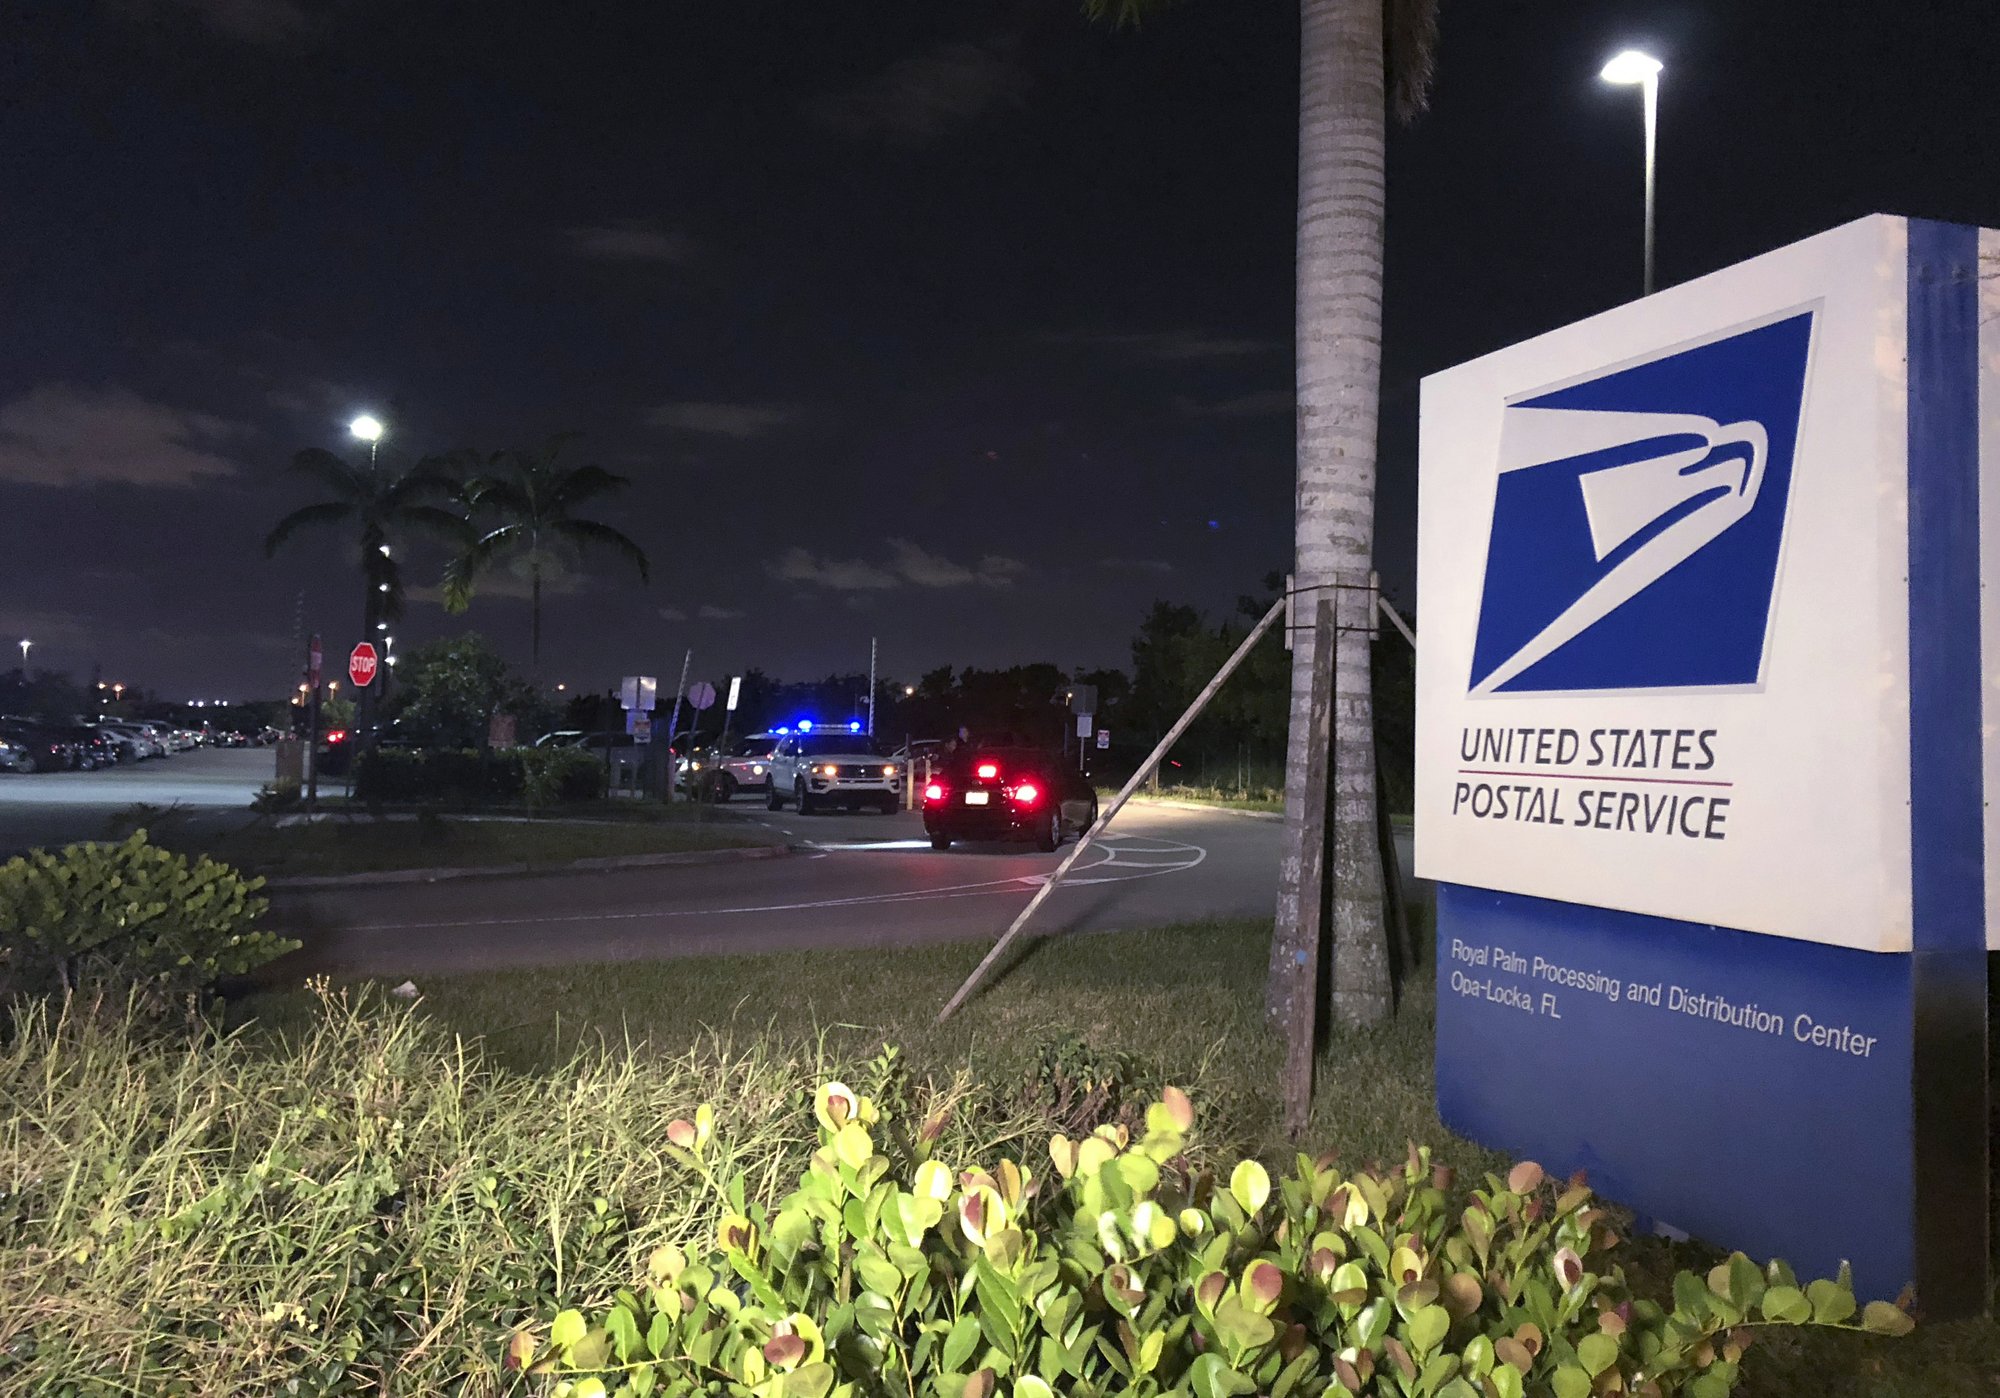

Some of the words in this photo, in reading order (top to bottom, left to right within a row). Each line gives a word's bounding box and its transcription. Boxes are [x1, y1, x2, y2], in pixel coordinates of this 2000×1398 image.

[351, 656, 375, 673] STOP
[1461, 728, 1579, 764] UNITED
[1587, 729, 1717, 770] STATES
[1453, 783, 1564, 824] POSTAL
[1574, 790, 1730, 840] SERVICE
[1451, 971, 1534, 1014] Opa-Locka,
[1540, 994, 1562, 1019] FL
[1451, 939, 1488, 967] Royal
[1493, 947, 1527, 975] Palm
[1533, 957, 1620, 1001] Processing
[1627, 980, 1661, 1007] and
[1669, 987, 1784, 1035] Distribution
[1794, 1015, 1876, 1058] Center
